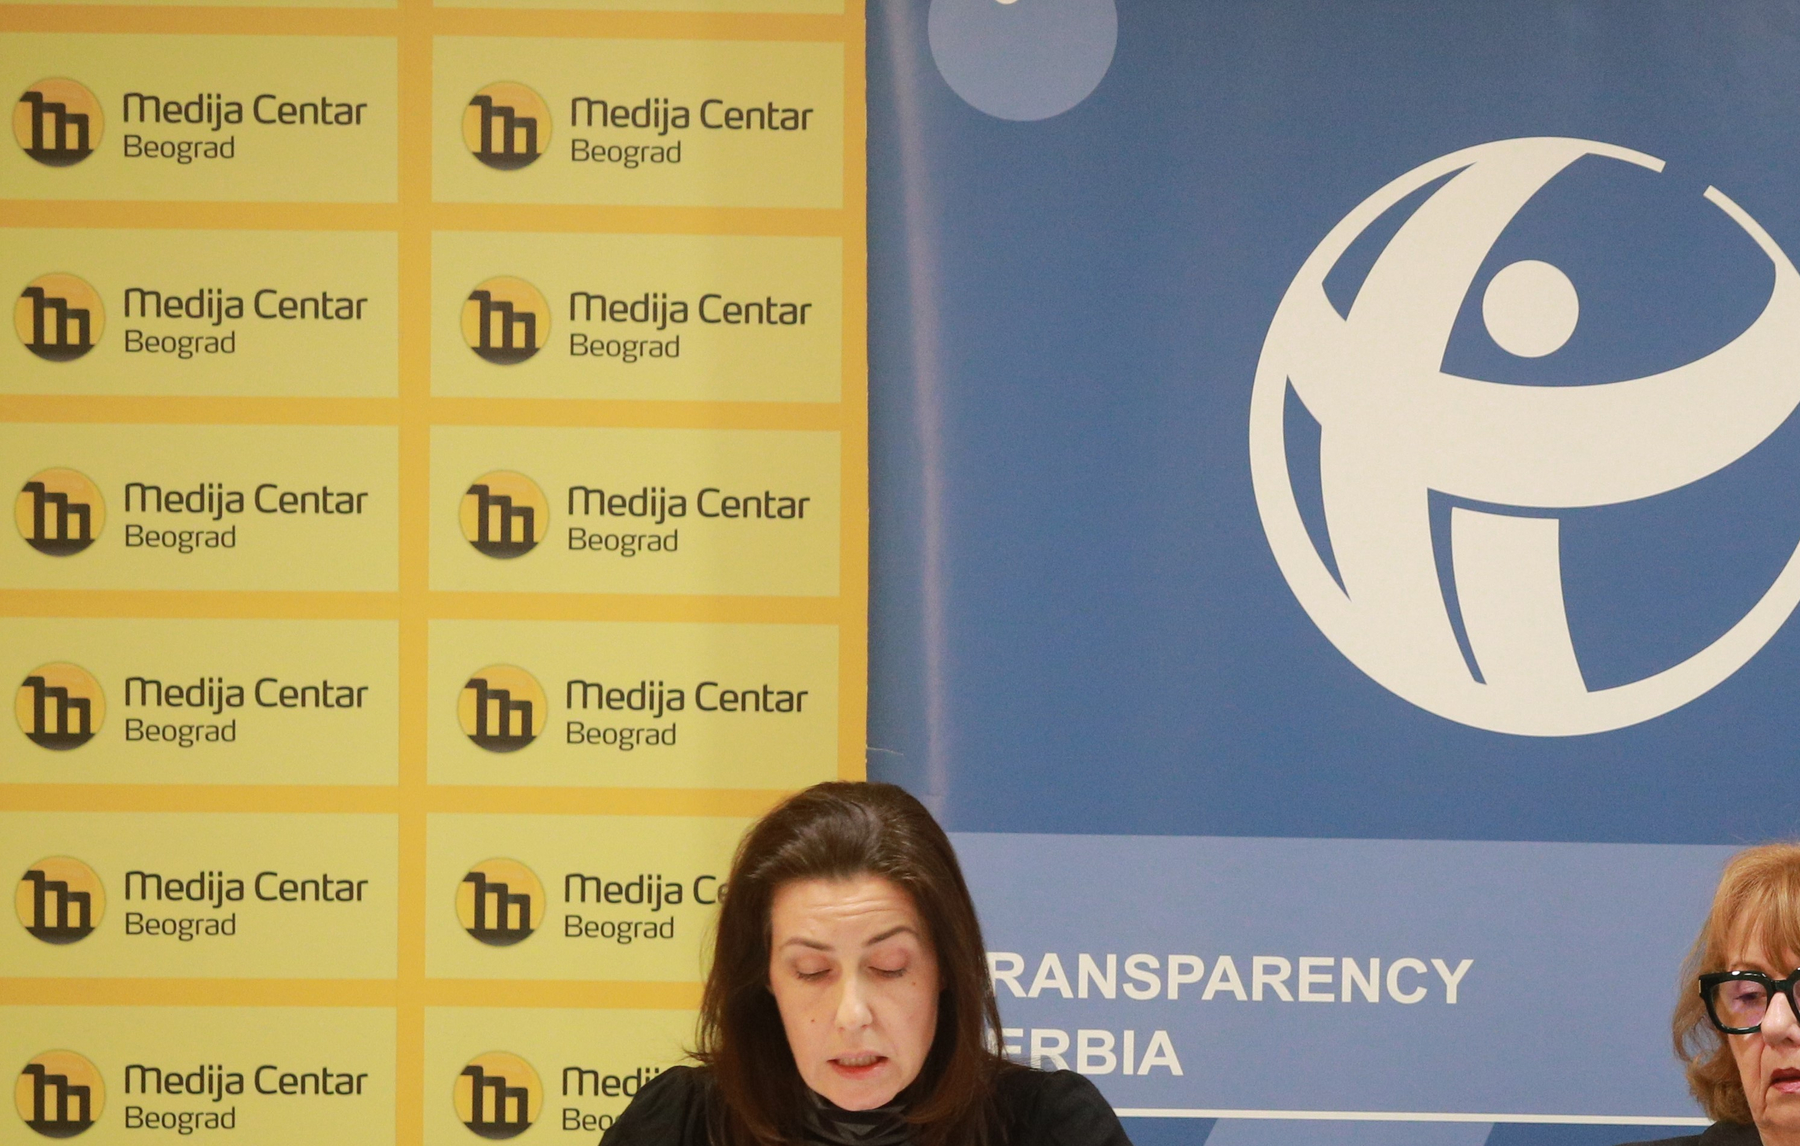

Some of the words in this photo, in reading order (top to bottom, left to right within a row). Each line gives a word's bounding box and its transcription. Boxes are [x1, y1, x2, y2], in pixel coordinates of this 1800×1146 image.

[123, 92, 243, 132] Medija
[252, 93, 368, 126] Centar
[571, 96, 690, 137] Medija
[699, 98, 814, 131] Centar
[123, 134, 235, 165] Beograd
[571, 138, 682, 170] Beograd
[124, 287, 244, 327] Medija
[253, 288, 369, 321] Centar
[569, 291, 689, 331] Medija
[698, 293, 813, 326] Centar
[124, 329, 236, 360] Beograd
[569, 332, 680, 364] Beograd
[124, 481, 245, 522] Medija
[254, 483, 369, 515] Centar
[568, 485, 687, 525] Medija
[696, 487, 811, 520] Centar
[125, 523, 236, 554] Beograd
[568, 527, 678, 558] Beograd
[124, 676, 245, 716] Medija
[254, 677, 369, 709] Centar
[566, 679, 685, 719] Medija
[695, 681, 809, 713] Centar
[125, 718, 236, 749] Beograd
[566, 721, 677, 752] Beograd
[124, 870, 245, 909] Medija
[254, 870, 369, 902] Centar
[564, 872, 683, 912] Medija
[125, 911, 236, 942] Beograd
[564, 914, 675, 945] Beograd
[984, 951, 1474, 1005] RANSPARENCY
[988, 1028, 1184, 1076] ERBIA
[124, 1063, 245, 1103] Medija
[254, 1064, 369, 1096] Centar
[125, 1105, 236, 1136] Beograd
